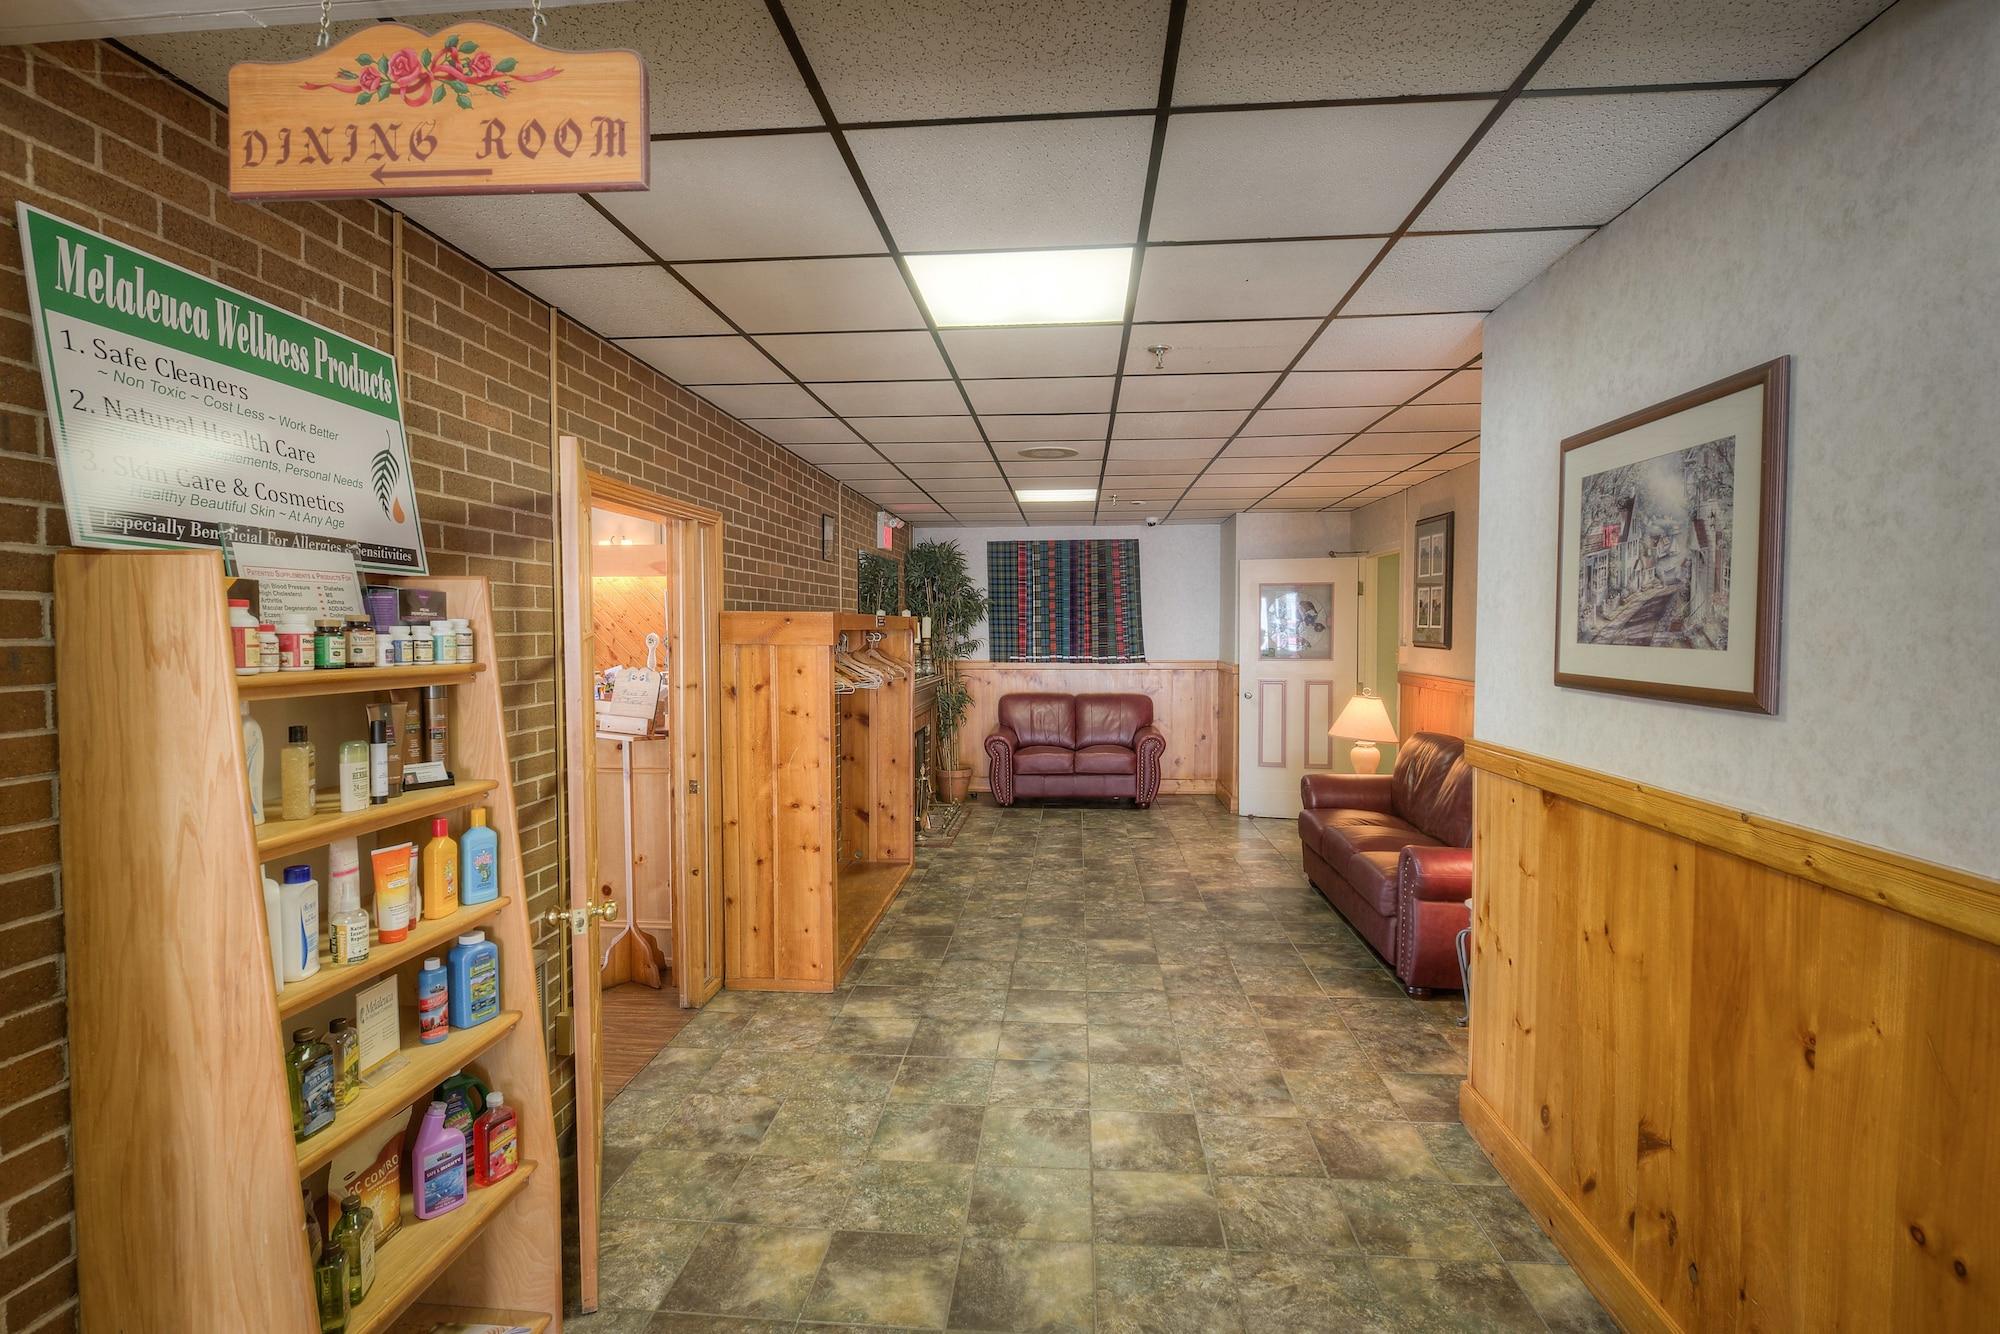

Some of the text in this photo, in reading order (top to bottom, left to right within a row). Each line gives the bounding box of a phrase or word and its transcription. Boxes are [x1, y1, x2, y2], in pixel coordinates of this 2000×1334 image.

[241, 116, 629, 168] DINING ROOM
[55, 236, 392, 404] Melaleuca Wellness Products
[60, 330, 248, 400] 1. Safe Cleaners
[70, 389, 96, 414] 2.
[103, 396, 194, 435] Natural
[202, 421, 269, 453] Health
[276, 440, 316, 464] Care
[113, 370, 145, 389] Non
[151, 379, 186, 400] Toxic
[204, 395, 233, 412] Cost
[237, 404, 265, 421] Less
[279, 416, 306, 433] Work
[309, 423, 339, 441] Better
[113, 455, 168, 484] Skin
[176, 468, 226, 493] Care
[233, 478, 250, 498] &
[255, 482, 345, 513] Cosmetics
[285, 463, 331, 482] Personal
[334, 475, 363, 489] Needs
[103, 512, 186, 540] Especially
[267, 531, 288, 547] For
[292, 532, 345, 553] Allergies
[131, 484, 186, 506] Healthy
[191, 494, 246, 513] Beautiful
[250, 504, 275, 519] Skin
[288, 510, 300, 521] At
[303, 513, 323, 527] Any
[325, 515, 345, 530] Age
